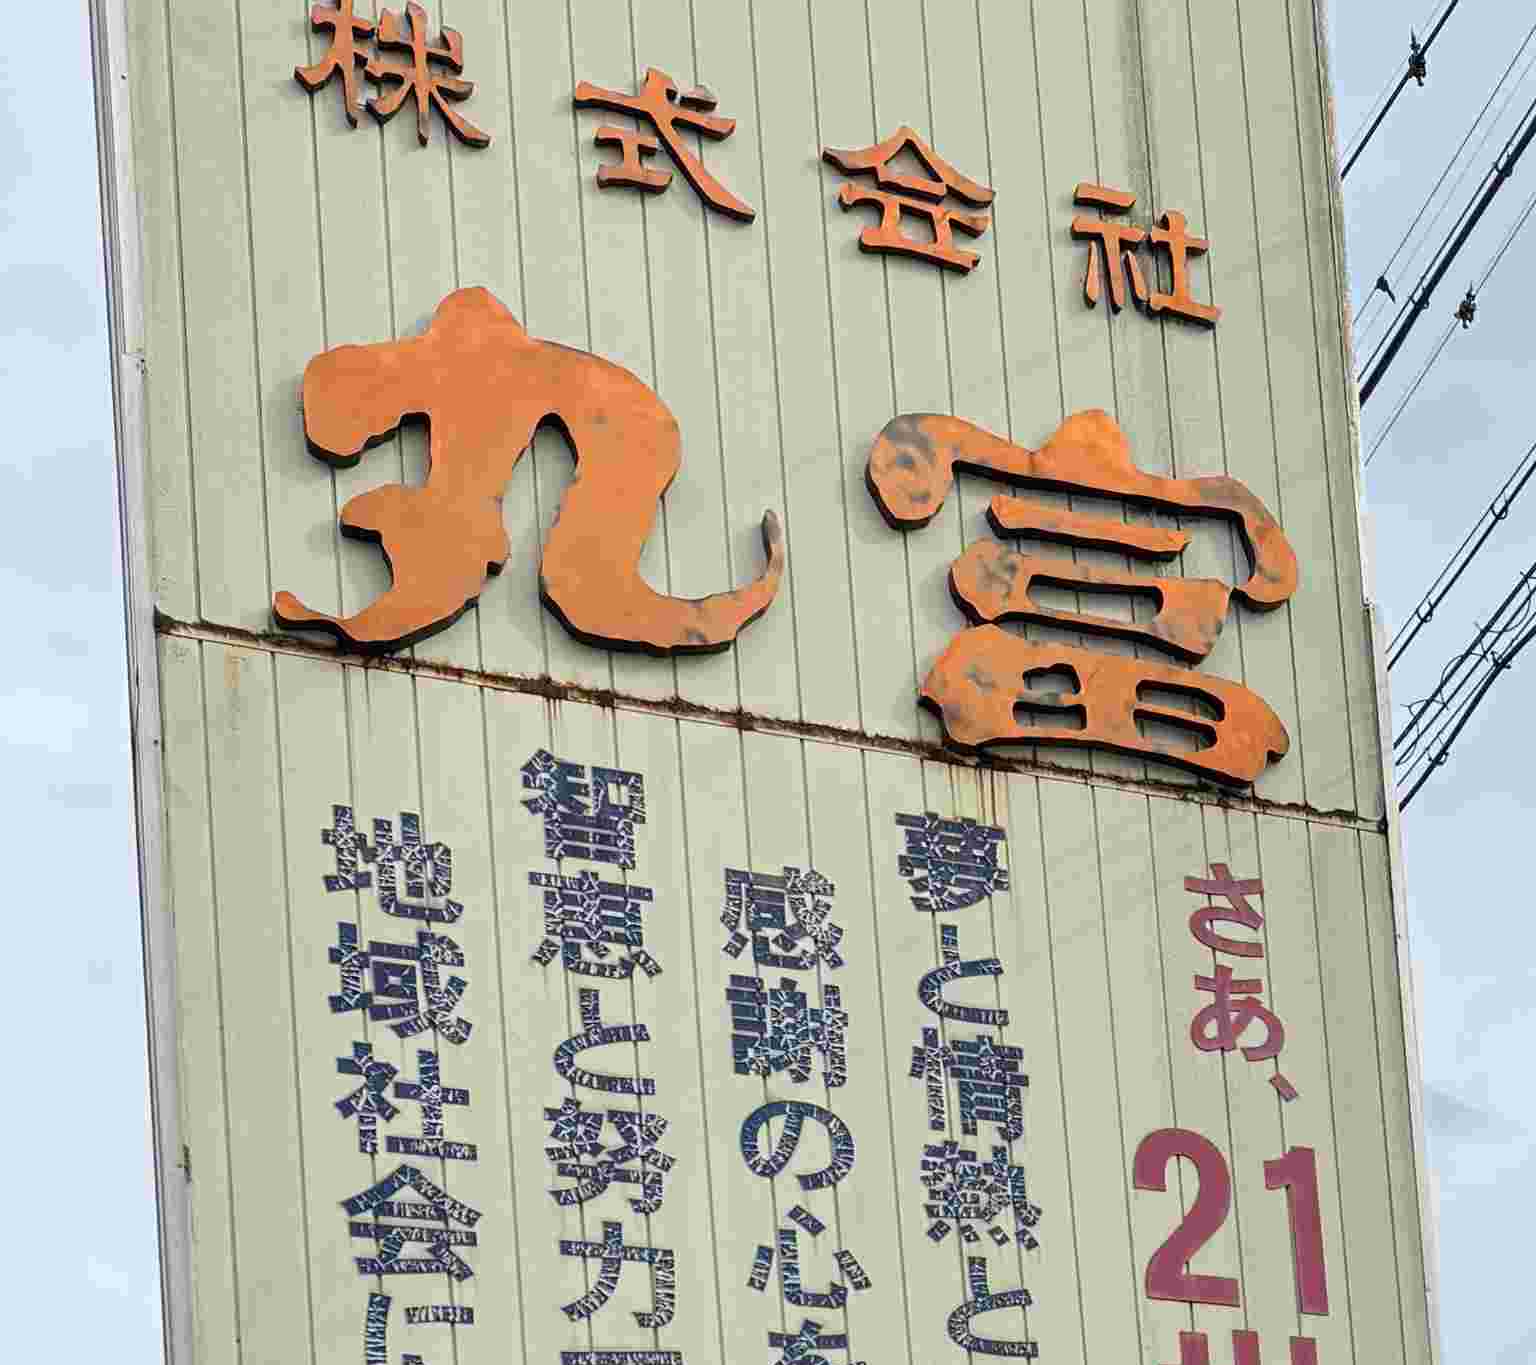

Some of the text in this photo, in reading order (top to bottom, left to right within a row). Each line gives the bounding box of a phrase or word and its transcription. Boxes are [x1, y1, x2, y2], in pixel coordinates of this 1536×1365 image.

[295, 0, 1221, 328] 株式会社
[895, 812, 1042, 1358] 夢と情熱と
